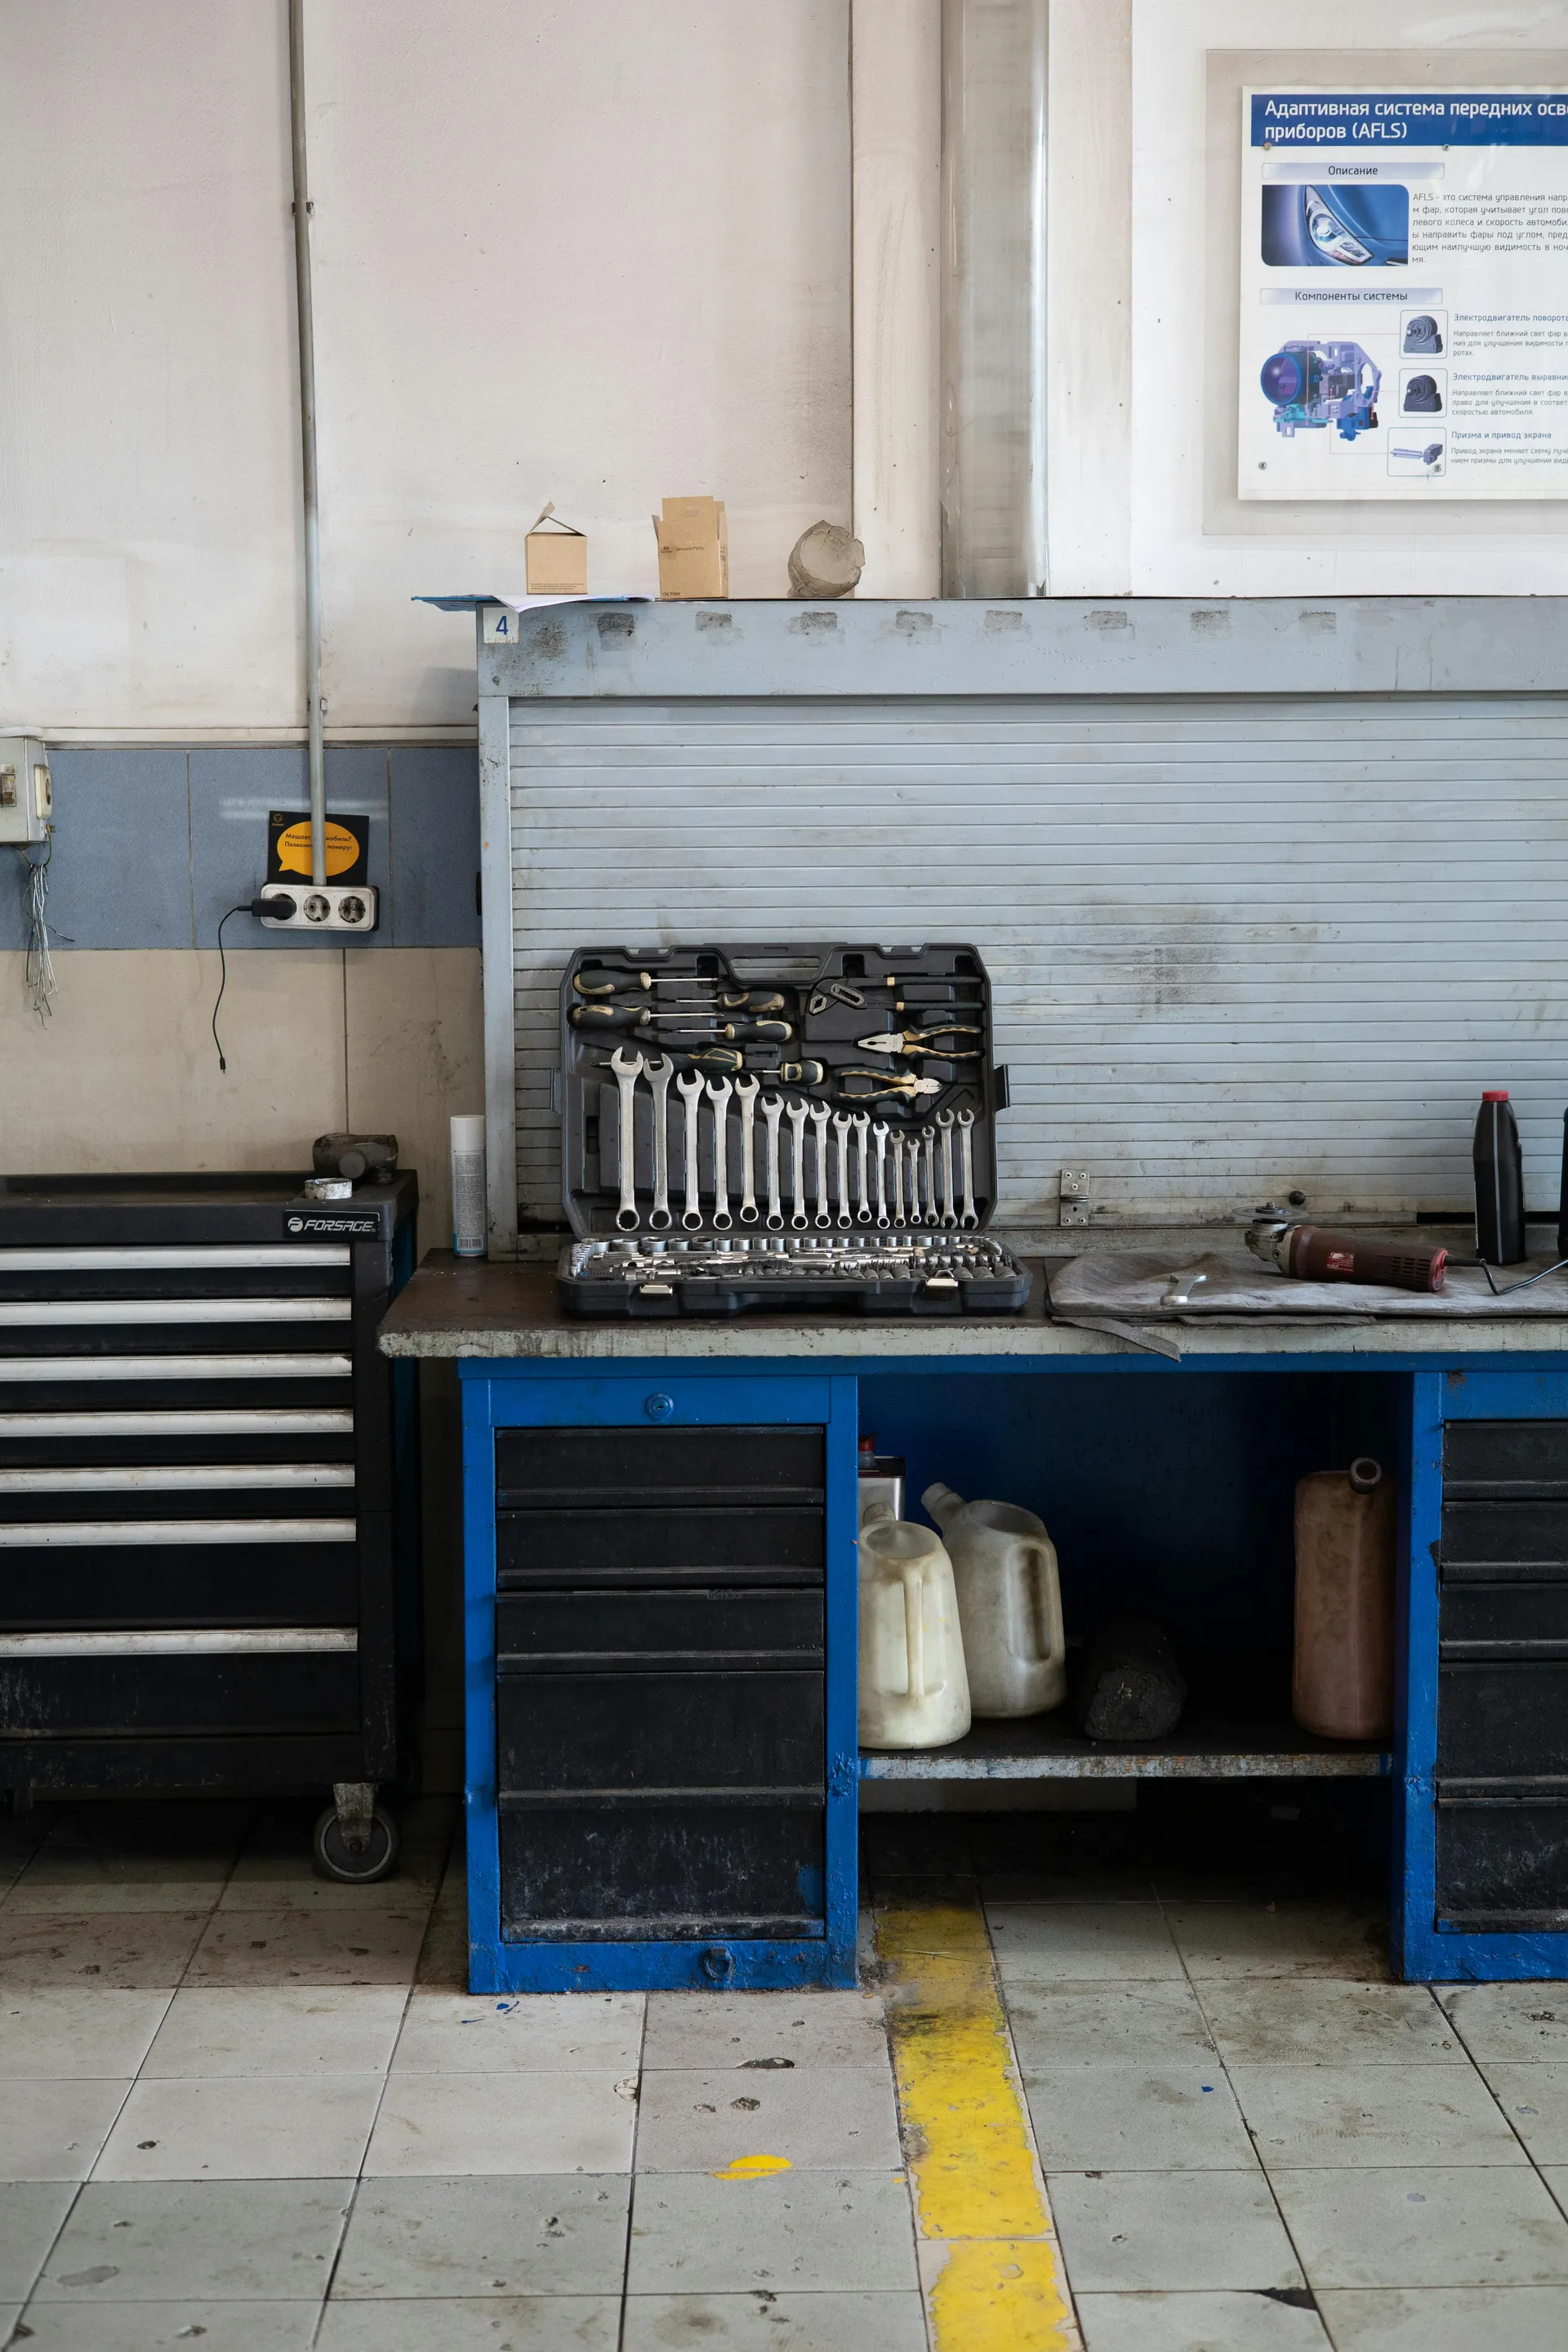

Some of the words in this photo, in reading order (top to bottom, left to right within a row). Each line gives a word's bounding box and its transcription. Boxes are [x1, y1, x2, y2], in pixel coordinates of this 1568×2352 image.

[1264, 100, 1370, 118] Адаптивная
[1374, 103, 1445, 116] система
[1450, 103, 1533, 119] передних
[1537, 103, 1568, 116] осв
[1264, 123, 1347, 141] приборов
[1352, 122, 1407, 139] (AFLS)
[1329, 165, 1379, 176] Описание
[1413, 193, 1434, 201] AFLS
[1495, 194, 1546, 203] управления
[1548, 194, 1568, 203] напр
[1423, 206, 1442, 215] фар,
[1445, 207, 1478, 215] которая
[1481, 207, 1526, 215] учитывает
[1529, 207, 1549, 215] угол
[1486, 219, 1524, 227] скорость
[1526, 217, 1568, 225] автомоби
[1470, 230, 1494, 239] фары
[1517, 232, 1545, 240] углом,
[1441, 244, 1491, 252] наилучшую
[1294, 291, 1361, 301] Компоненты
[1364, 292, 1408, 301] системы
[1454, 313, 1530, 323] Электродвигатель
[1453, 372, 1530, 381] Электродвигатель
[1547, 389, 1561, 397] фар
[1491, 399, 1531, 408] улучшения
[1452, 408, 1489, 416] скоростью
[1452, 431, 1482, 440] Призма
[1492, 432, 1522, 440] привод
[1451, 447, 1477, 455] Привод
[496, 615, 509, 635] 4
[303, 1219, 375, 1232] FORSAGE
